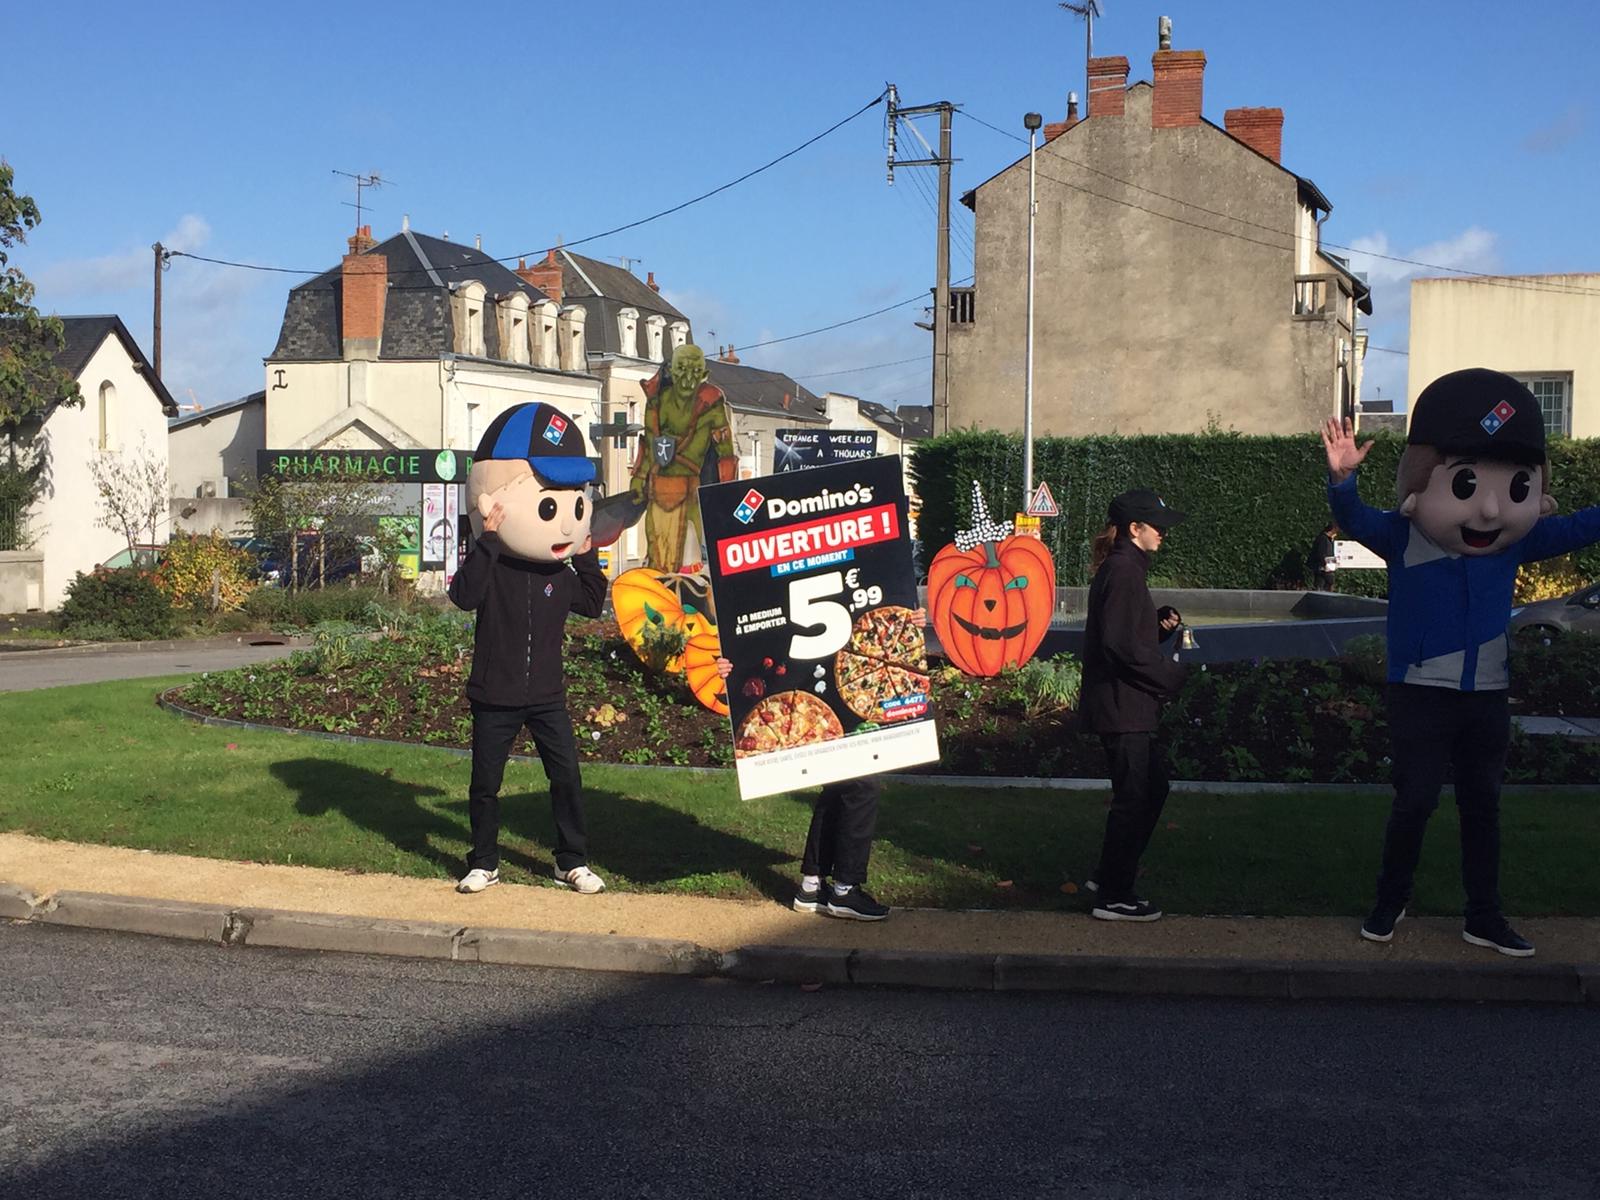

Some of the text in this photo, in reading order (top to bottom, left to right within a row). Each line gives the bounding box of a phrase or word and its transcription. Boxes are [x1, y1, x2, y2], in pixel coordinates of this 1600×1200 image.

[783, 434, 819, 443] ETRANGE
[833, 449, 872, 459] THOUARS
[278, 455, 420, 475] PHARMACIE
[767, 483, 871, 520] Domino's
[726, 511, 891, 568] OUVERTURE !
[777, 551, 848, 573] EN CE MOMENT
[735, 616, 787, 635] À EMPORTER
[737, 607, 783, 624] LA MEDIUM
[789, 571, 852, 660] 5
